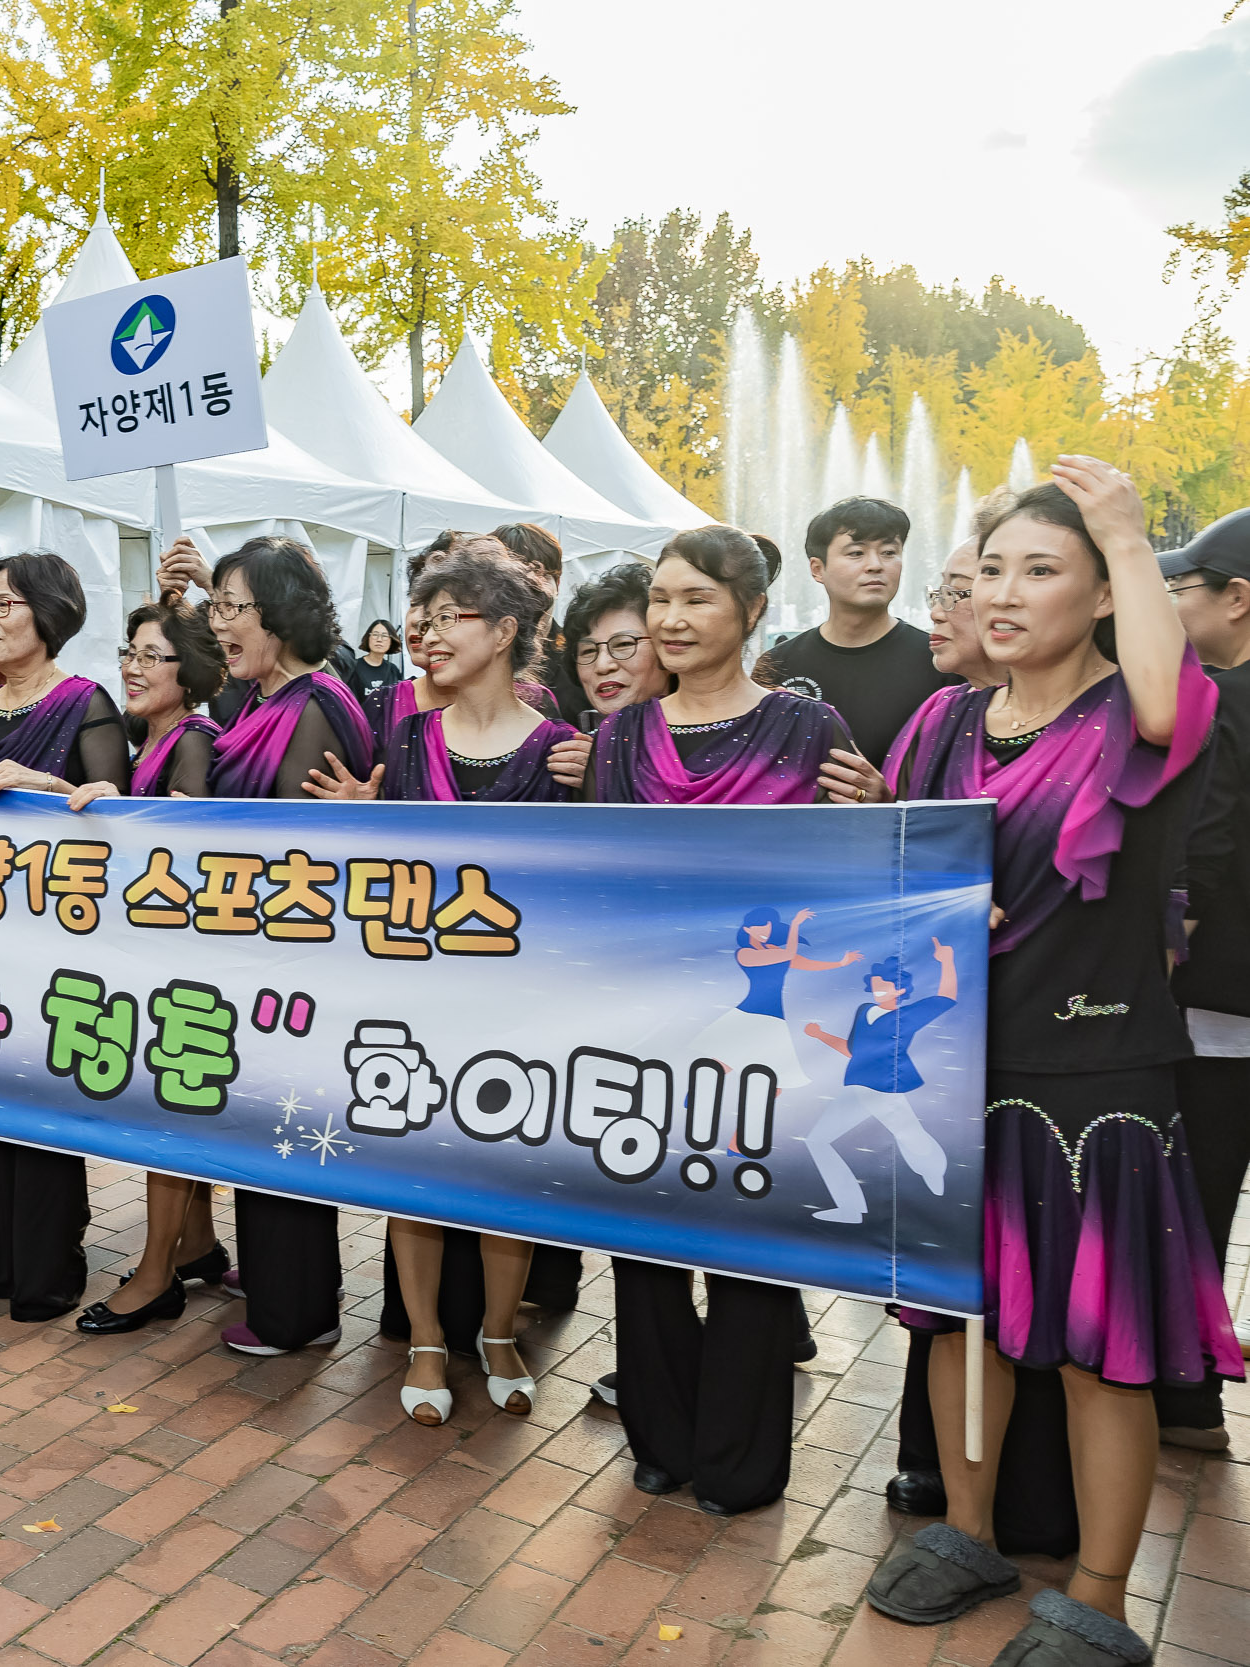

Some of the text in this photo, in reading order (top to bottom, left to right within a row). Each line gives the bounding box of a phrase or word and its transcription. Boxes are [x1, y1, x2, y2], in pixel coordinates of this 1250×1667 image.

[79, 372, 232, 436] 자양제1동
[41, 968, 315, 1115] 청춘"
[344, 1019, 777, 1200] 화이팅!!
